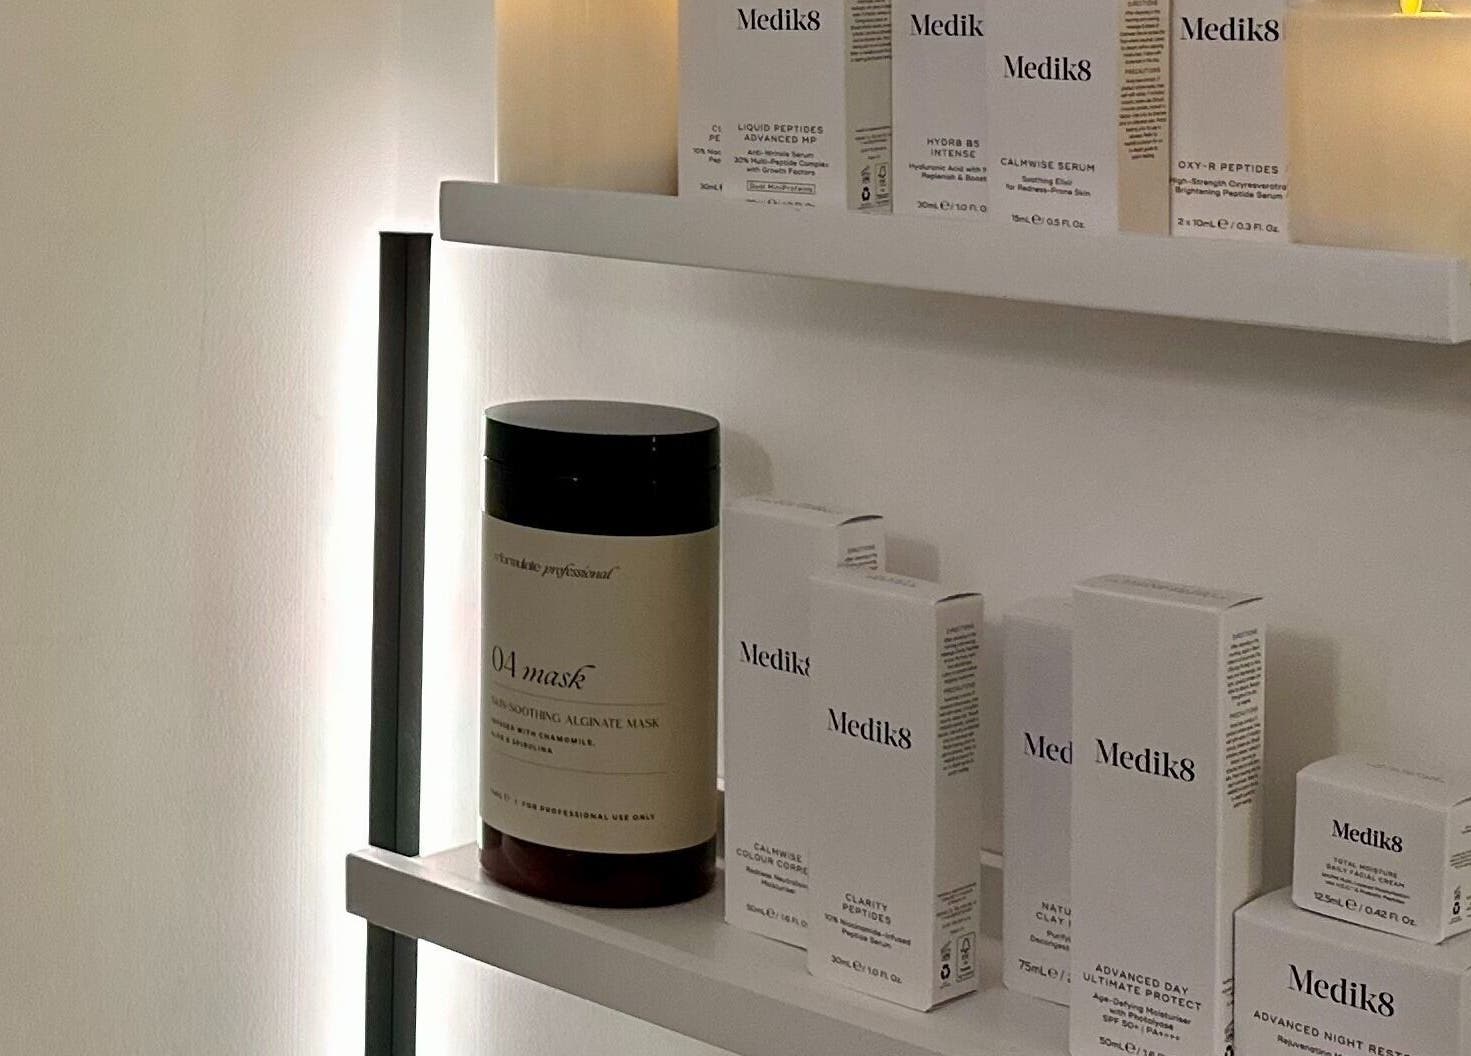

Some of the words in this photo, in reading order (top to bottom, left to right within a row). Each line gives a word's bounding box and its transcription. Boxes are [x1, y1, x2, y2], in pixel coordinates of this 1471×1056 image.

[737, 8, 821, 31] Medik8
[911, 13, 985, 37] Medik
[1180, 17, 1279, 42] Medik8
[1003, 55, 1092, 82] Medik8
[738, 124, 771, 133] LIQUID
[774, 125, 824, 135] PEPTIDES
[744, 134, 798, 144] ADVANCED
[802, 136, 817, 144] MP
[751, 157, 797, 167] Multi-Peptide
[799, 159, 829, 168] Complex
[791, 151, 814, 159] Serum
[930, 149, 977, 159] INTENSE
[762, 167, 787, 175] Growth
[788, 168, 816, 176] Factors
[908, 163, 946, 172] Hyaluronic
[948, 165, 964, 173] Acid
[1000, 157, 1054, 170] CALMWISE
[1057, 161, 1095, 172] SERUM
[1178, 160, 1216, 171] OXY-R
[1220, 162, 1279, 174] PEPTIDES
[921, 172, 956, 182] Replenish
[965, 174, 987, 183] Boost
[1170, 177, 1227, 188] High-Strength
[1017, 184, 1073, 196] Redness-Prone
[1074, 187, 1091, 197] Skin
[1175, 186, 1221, 197] Brightening
[1223, 189, 1254, 199] Peptide
[1257, 191, 1283, 200] Serum
[1178, 217, 1184, 225] 2
[1192, 219, 1216, 228] 10mL
[542, 562, 621, 581] professional
[492, 645, 516, 678] 04
[522, 664, 596, 690] mask
[565, 714, 623, 729] ALGINATE
[627, 718, 660, 729] MASK
[828, 708, 913, 750] Medik8
[517, 727, 536, 738] WITH
[512, 739, 553, 754] SPIRULINA
[1024, 732, 1073, 765] Med
[1094, 737, 1196, 783] Medik8
[521, 800, 537, 811] FOR
[539, 804, 609, 821] PROFESSIONAL
[612, 813, 629, 821] USE
[632, 813, 655, 821] ONLY
[1331, 819, 1403, 853] Medik8
[736, 848, 774, 865] COLOUR
[754, 842, 802, 863] CALMWISE
[1326, 863, 1348, 875] DAILY
[1378, 877, 1406, 889] CREAM
[1334, 856, 1356, 869] TOTAL
[1359, 863, 1398, 880] MOISTURE
[845, 893, 888, 912] CLARITY
[1041, 901, 1071, 916] NATU
[842, 903, 892, 925] PEPTIDES
[841, 927, 868, 942] Peptide
[1018, 958, 1047, 977] 75mL
[1095, 963, 1160, 989] ADVANCED
[1164, 981, 1189, 995] DAY
[1083, 972, 1141, 996] ULTIMATE
[1145, 988, 1202, 1011] PROTECT
[1288, 963, 1395, 1018] Medik8
[1092, 992, 1144, 1014] Age-Defying
[1145, 1006, 1191, 1025] Moisturiser
[1102, 1014, 1119, 1025] SPF
[1121, 1019, 1139, 1029] 50+
[1109, 1007, 1126, 1017] with
[1128, 1012, 1174, 1031] Photolyase
[1253, 1009, 1320, 1038] ADVANCED
[1324, 1030, 1365, 1051] NIGHT
[1099, 1036, 1125, 1052] 50mL
